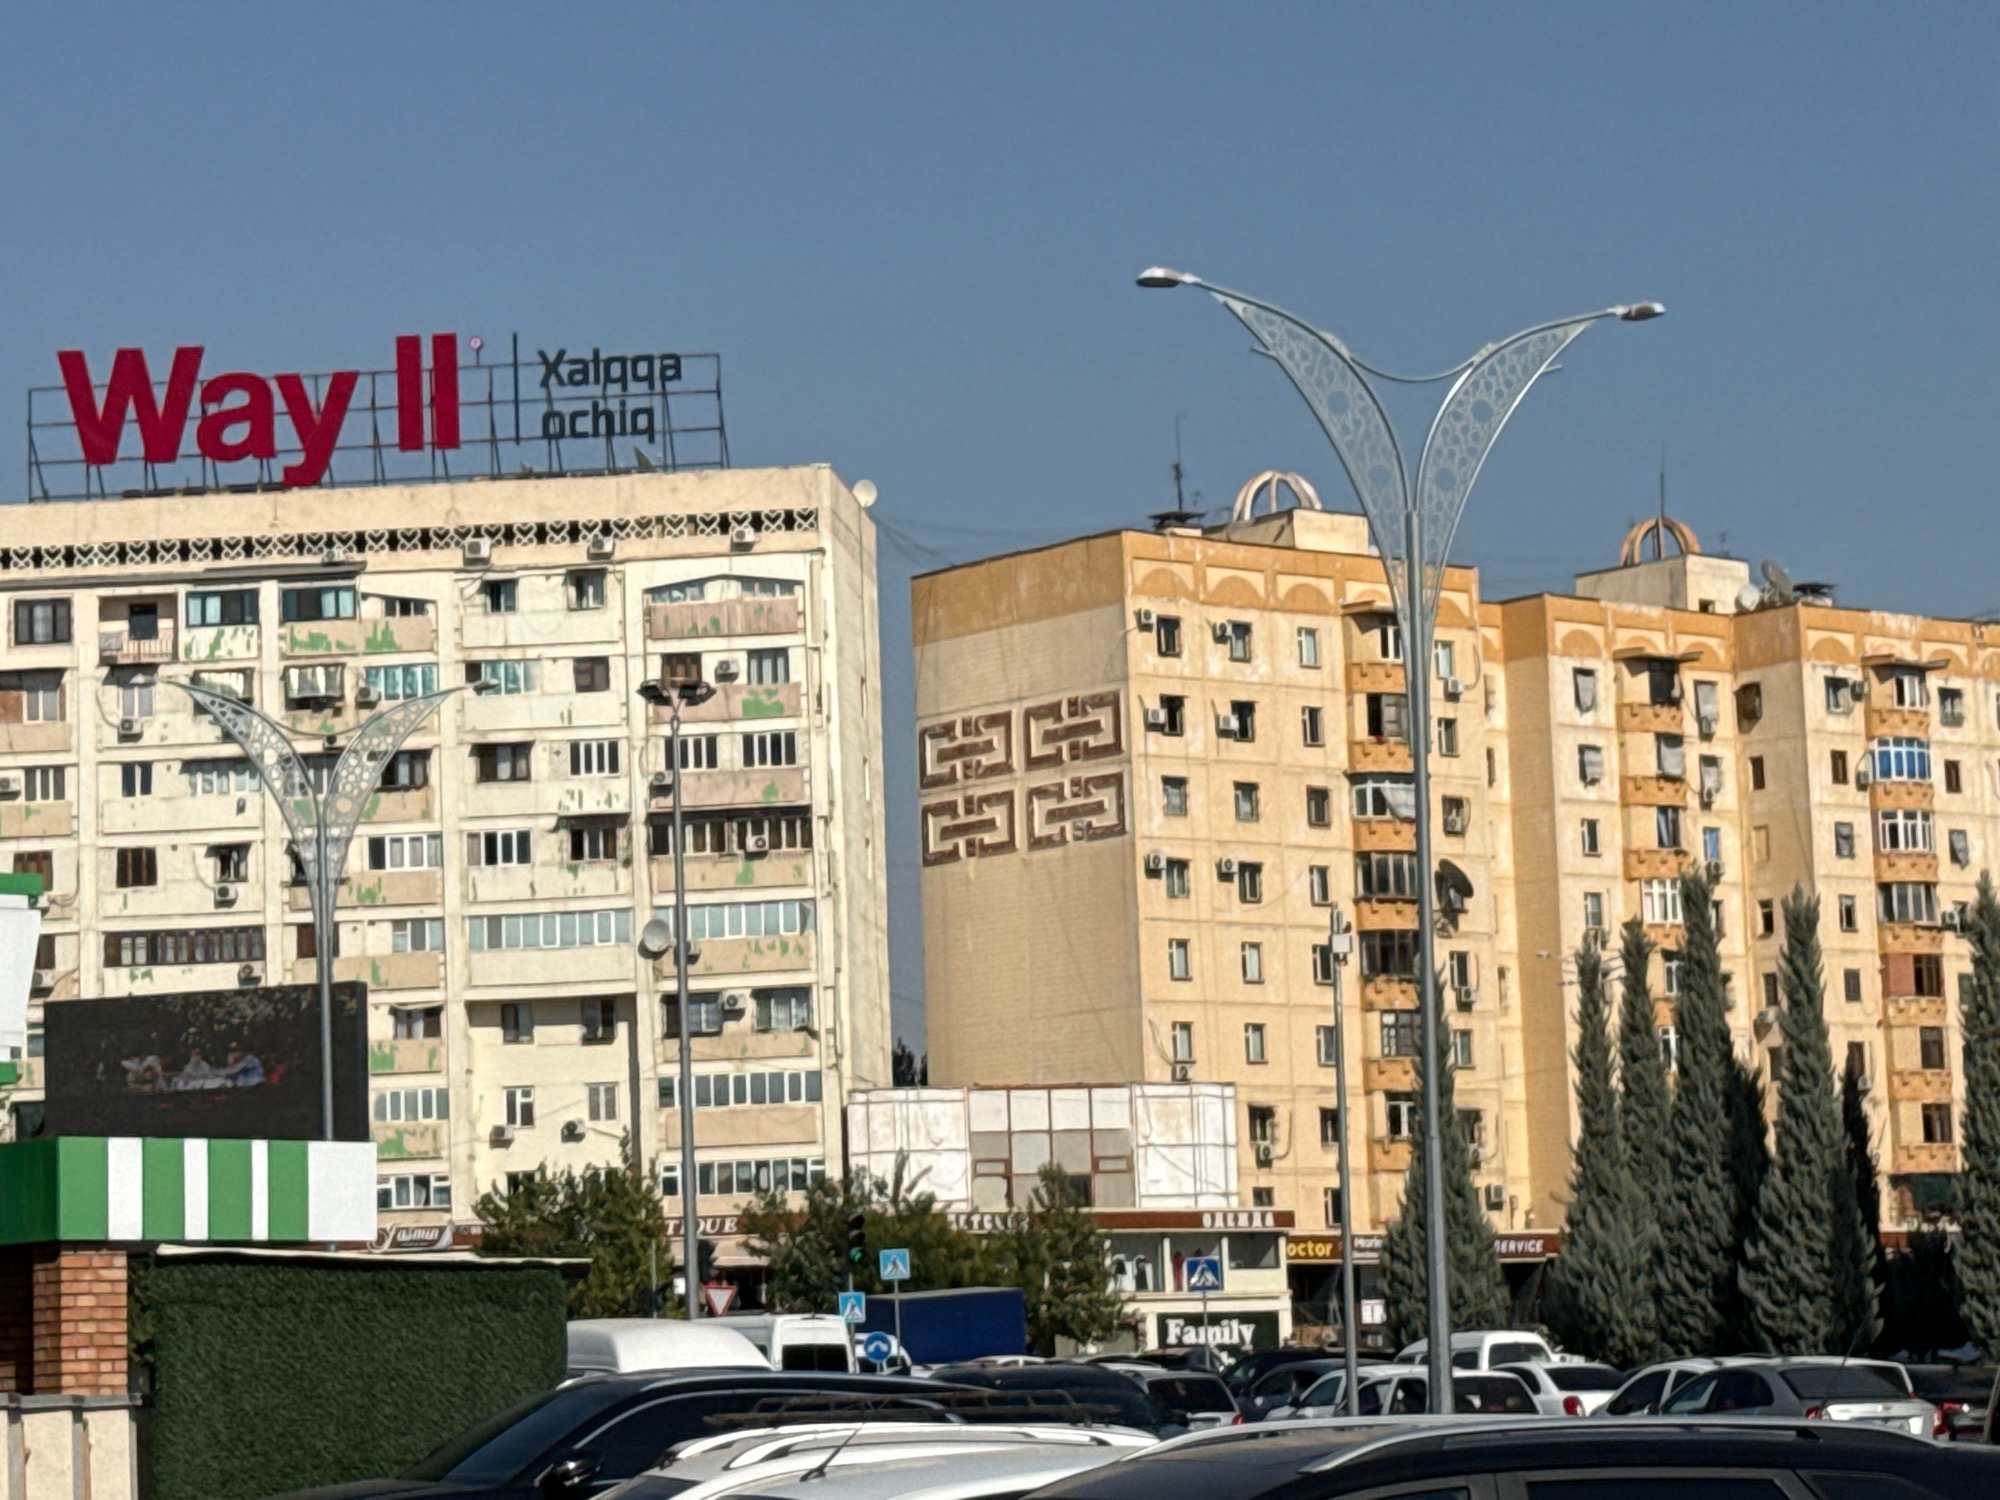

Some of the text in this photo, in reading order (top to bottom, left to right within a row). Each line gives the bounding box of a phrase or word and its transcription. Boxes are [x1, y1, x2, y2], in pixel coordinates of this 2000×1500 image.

[537, 347, 682, 393] Xalqqa
[57, 346, 360, 488] Way
[541, 399, 655, 444] ochiq
[1202, 1211, 1275, 1229] ОДЕЖДА
[1287, 1240, 1333, 1257] octor
[1166, 1318, 1255, 1351] Family
